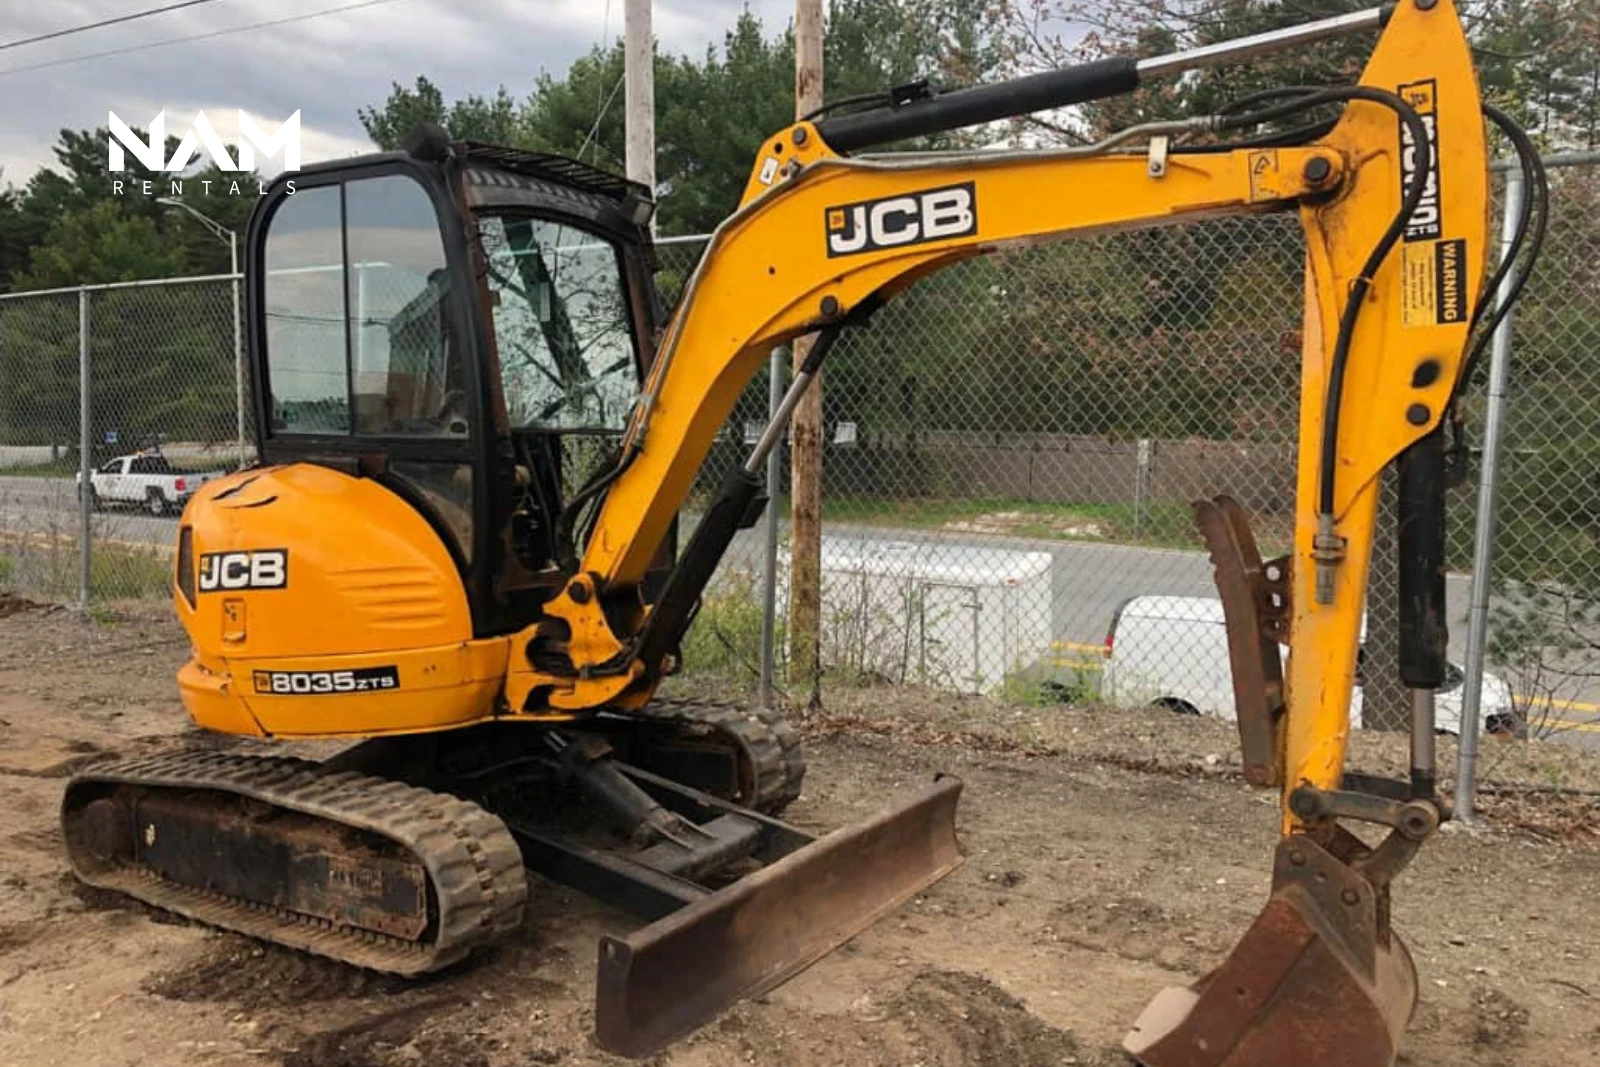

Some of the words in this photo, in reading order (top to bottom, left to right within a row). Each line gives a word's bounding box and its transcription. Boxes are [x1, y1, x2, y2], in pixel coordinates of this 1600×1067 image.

[830, 188, 974, 252] JCB
[1442, 243, 1458, 320] WARNING
[200, 552, 285, 590] JCB
[271, 671, 356, 692] 8035
